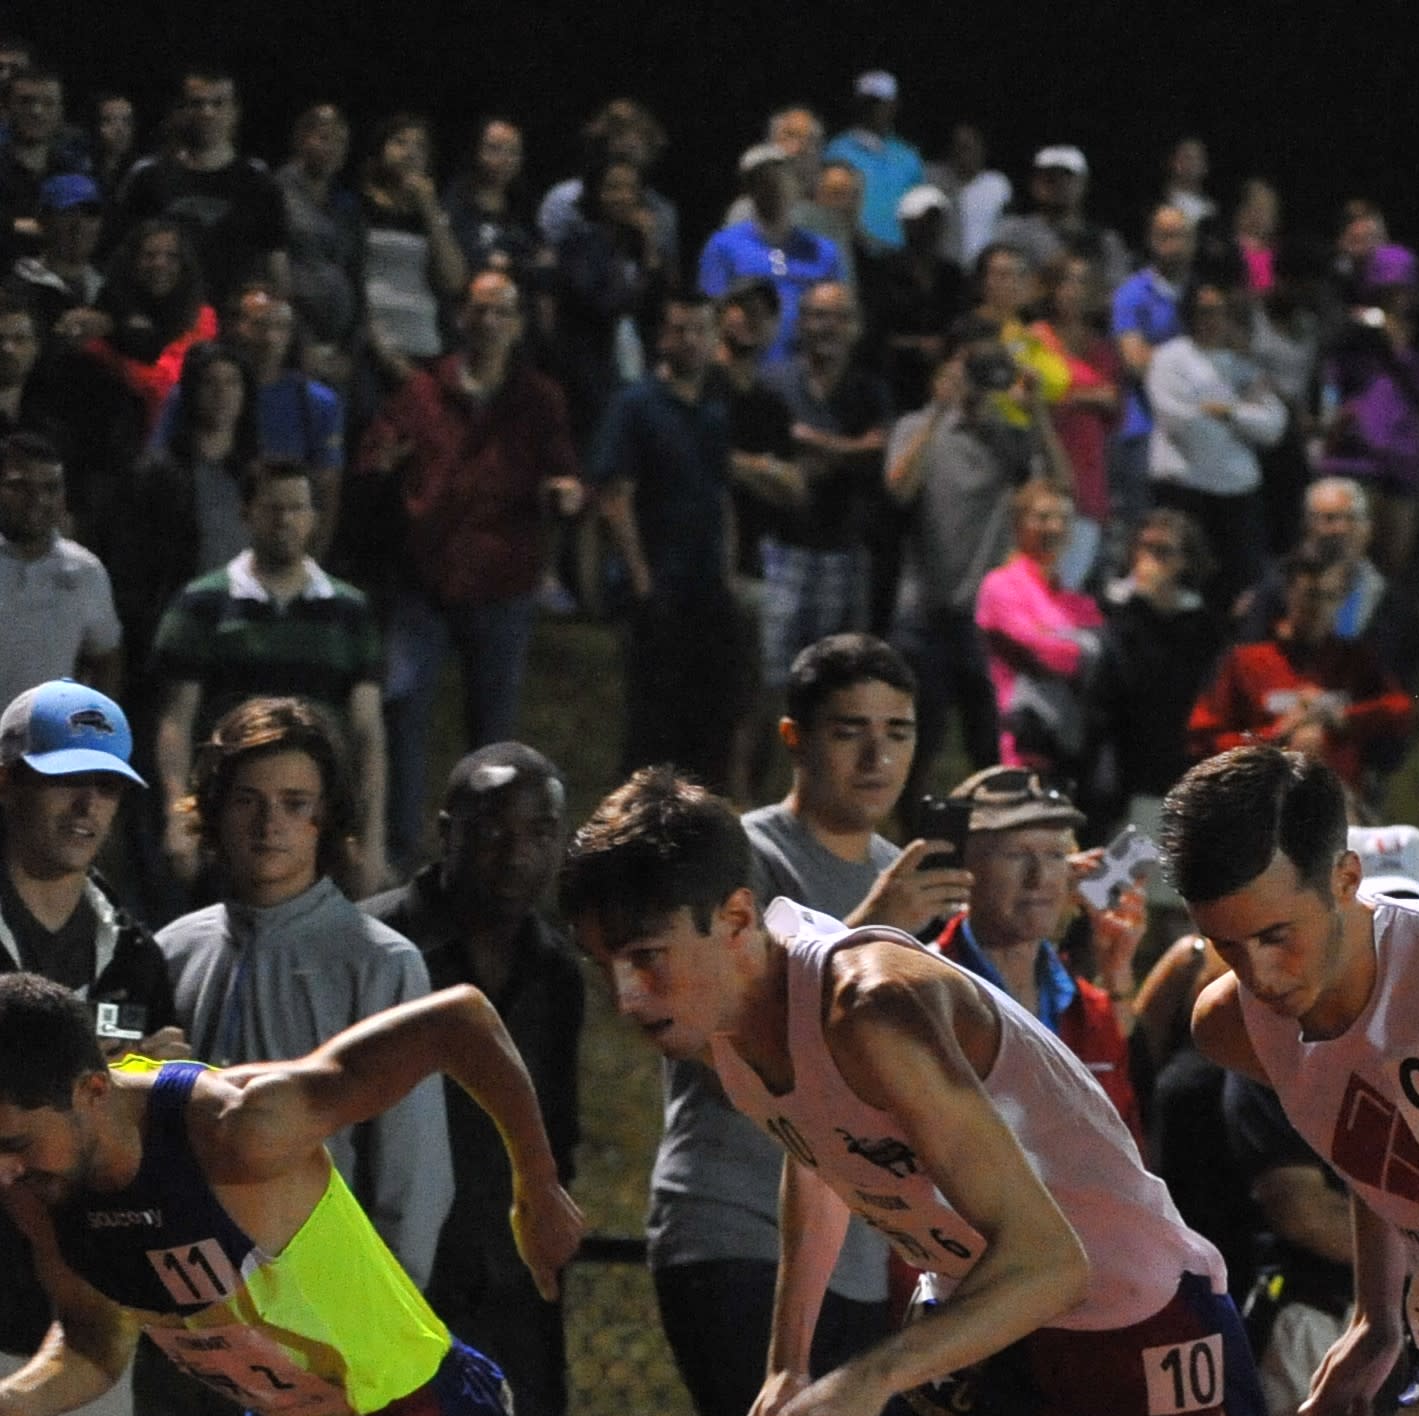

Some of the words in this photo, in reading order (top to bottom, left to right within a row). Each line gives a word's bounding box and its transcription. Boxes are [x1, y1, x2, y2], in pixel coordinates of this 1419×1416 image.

[767, 1116, 819, 1168] 10
[162, 1245, 228, 1300] 11
[249, 1364, 296, 1390] 2
[1160, 1341, 1217, 1409] 10
